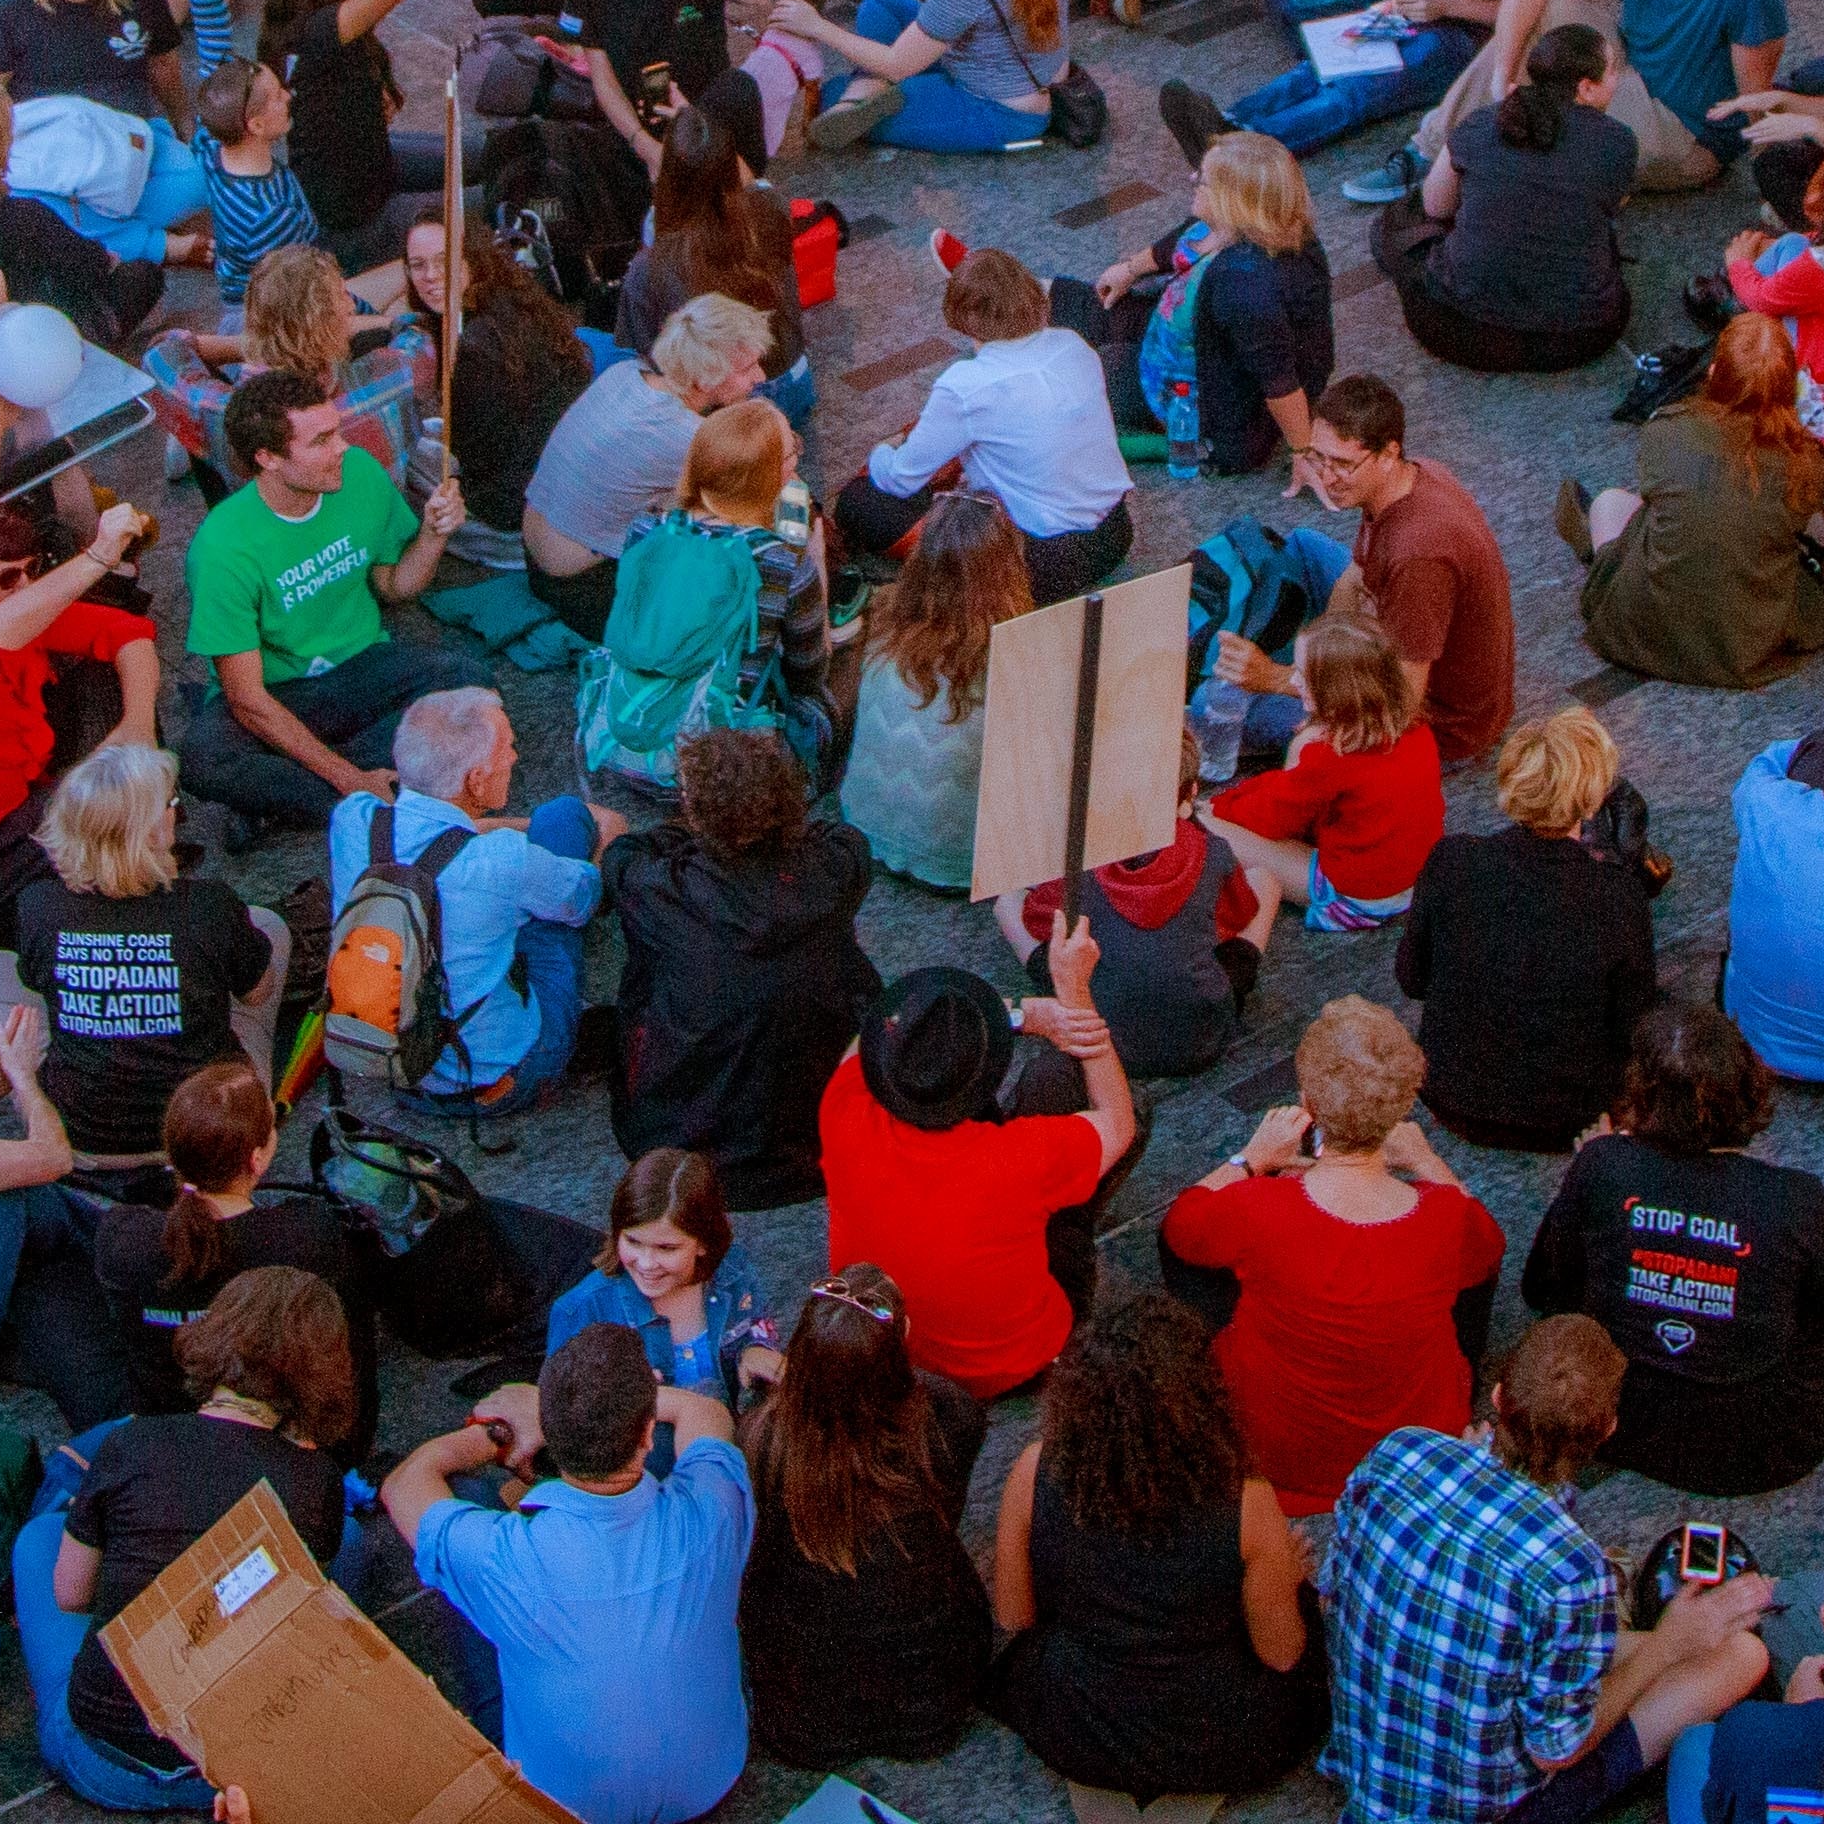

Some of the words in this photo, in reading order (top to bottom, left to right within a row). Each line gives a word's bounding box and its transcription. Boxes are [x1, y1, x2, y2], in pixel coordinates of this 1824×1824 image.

[275, 556, 316, 591] YOUR
[317, 534, 354, 568] VOTE
[282, 591, 295, 612] IS
[57, 945, 88, 962] SAYS
[91, 947, 112, 962] NO
[116, 947, 134, 962] TO
[137, 947, 174, 963] COAL
[58, 931, 124, 948] SUNSHINE
[127, 933, 172, 949] COAST
[54, 964, 180, 991] #STOPADANI
[58, 989, 102, 1017] TAKE
[105, 993, 181, 1017] ACTION
[58, 1013, 183, 1038] STOPADANI.COM
[1632, 1205, 1686, 1234] STOP
[1689, 1215, 1741, 1247] COAL
[1631, 1248, 1738, 1287] #STOPADANI
[1628, 1267, 1670, 1293] TAKE
[1672, 1276, 1736, 1304] ACTION
[1627, 1285, 1734, 1319] STOPADANI.COM
